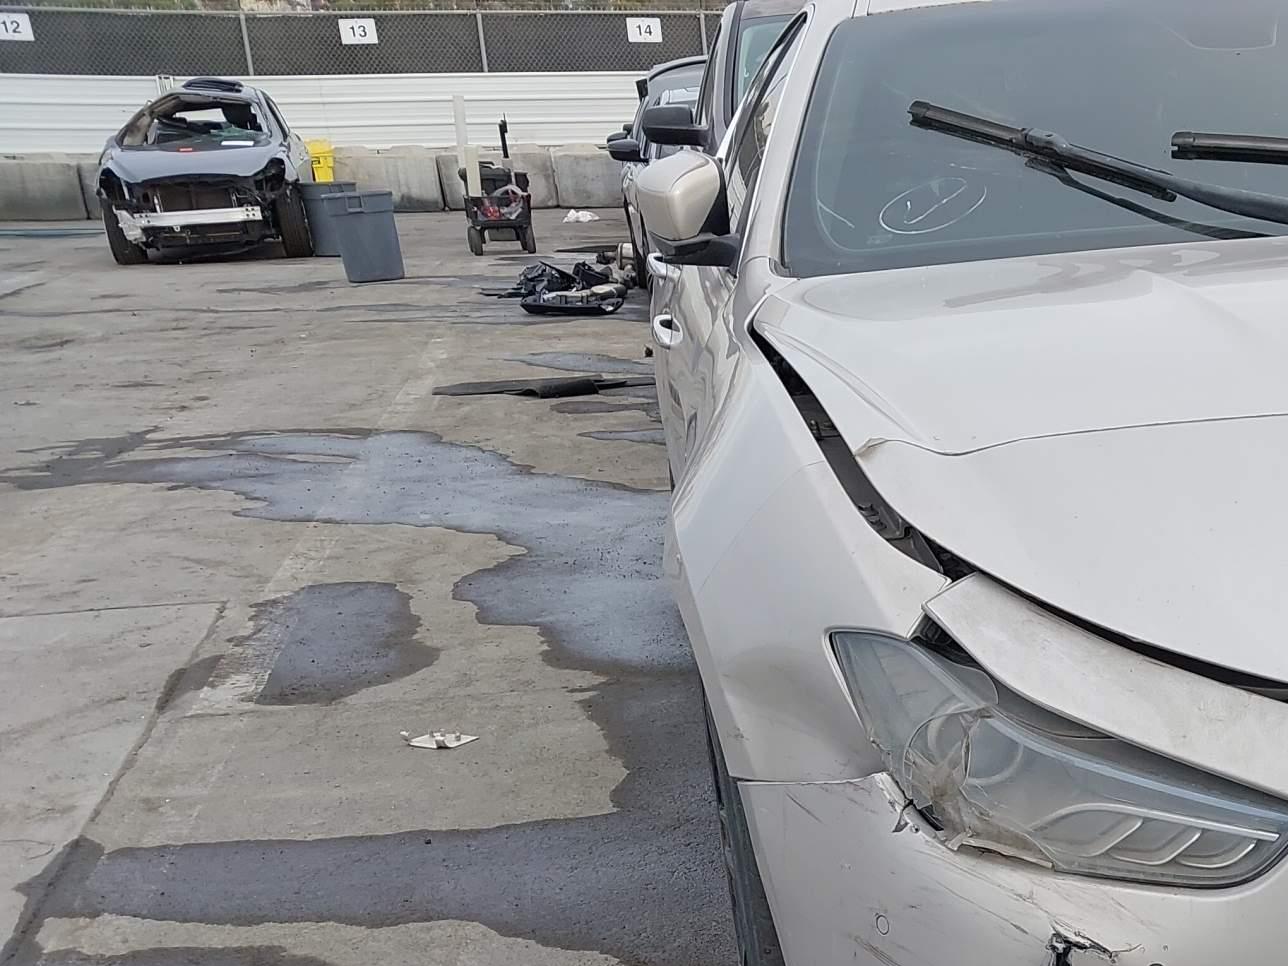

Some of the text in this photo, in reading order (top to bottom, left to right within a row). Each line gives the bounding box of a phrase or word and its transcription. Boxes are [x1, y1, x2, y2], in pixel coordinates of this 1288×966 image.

[0, 20, 22, 33] 12
[349, 25, 367, 38] 13
[636, 24, 653, 36] 14
